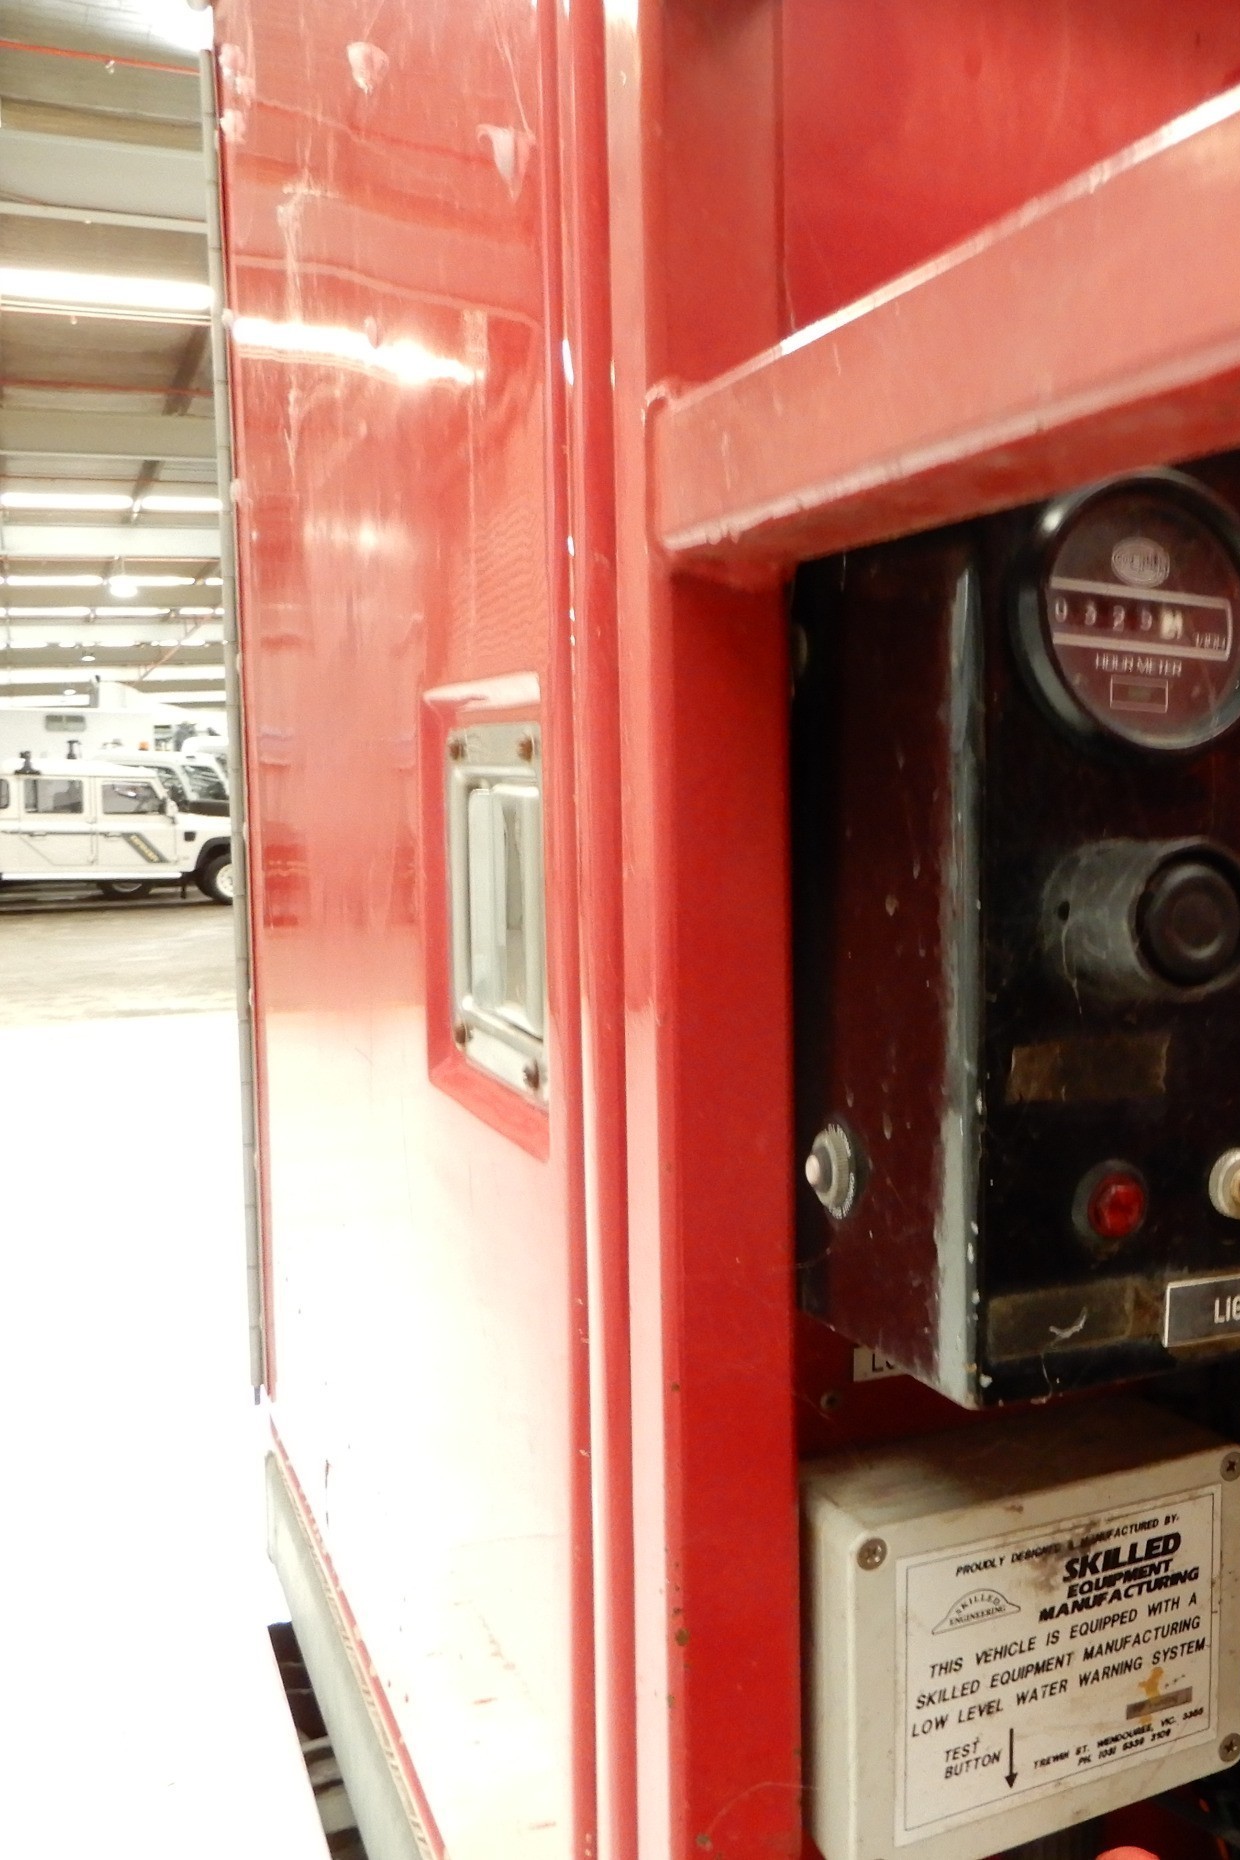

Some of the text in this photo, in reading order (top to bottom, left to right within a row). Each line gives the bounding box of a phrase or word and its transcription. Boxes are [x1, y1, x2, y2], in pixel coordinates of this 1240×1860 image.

[956, 1555, 1005, 1577] PROUDLY
[1063, 1531, 1182, 1583] SKILLED
[1067, 1558, 1174, 1599] EQUIPMENT
[955, 1593, 1001, 1614] SKILLED
[1038, 1566, 1200, 1623] MANUFACTURING
[930, 1591, 1198, 1679] THIS VEHICLE IS EQUIPPED WITH A
[916, 1615, 1201, 1710] SKILLED EQUIPMENT MANUFACTURING
[911, 1636, 1207, 1738] LOW LEVEL WATER WARNING SYSTEM
[944, 1749, 1002, 1780] BUTTON
[945, 1740, 980, 1763] TEST
